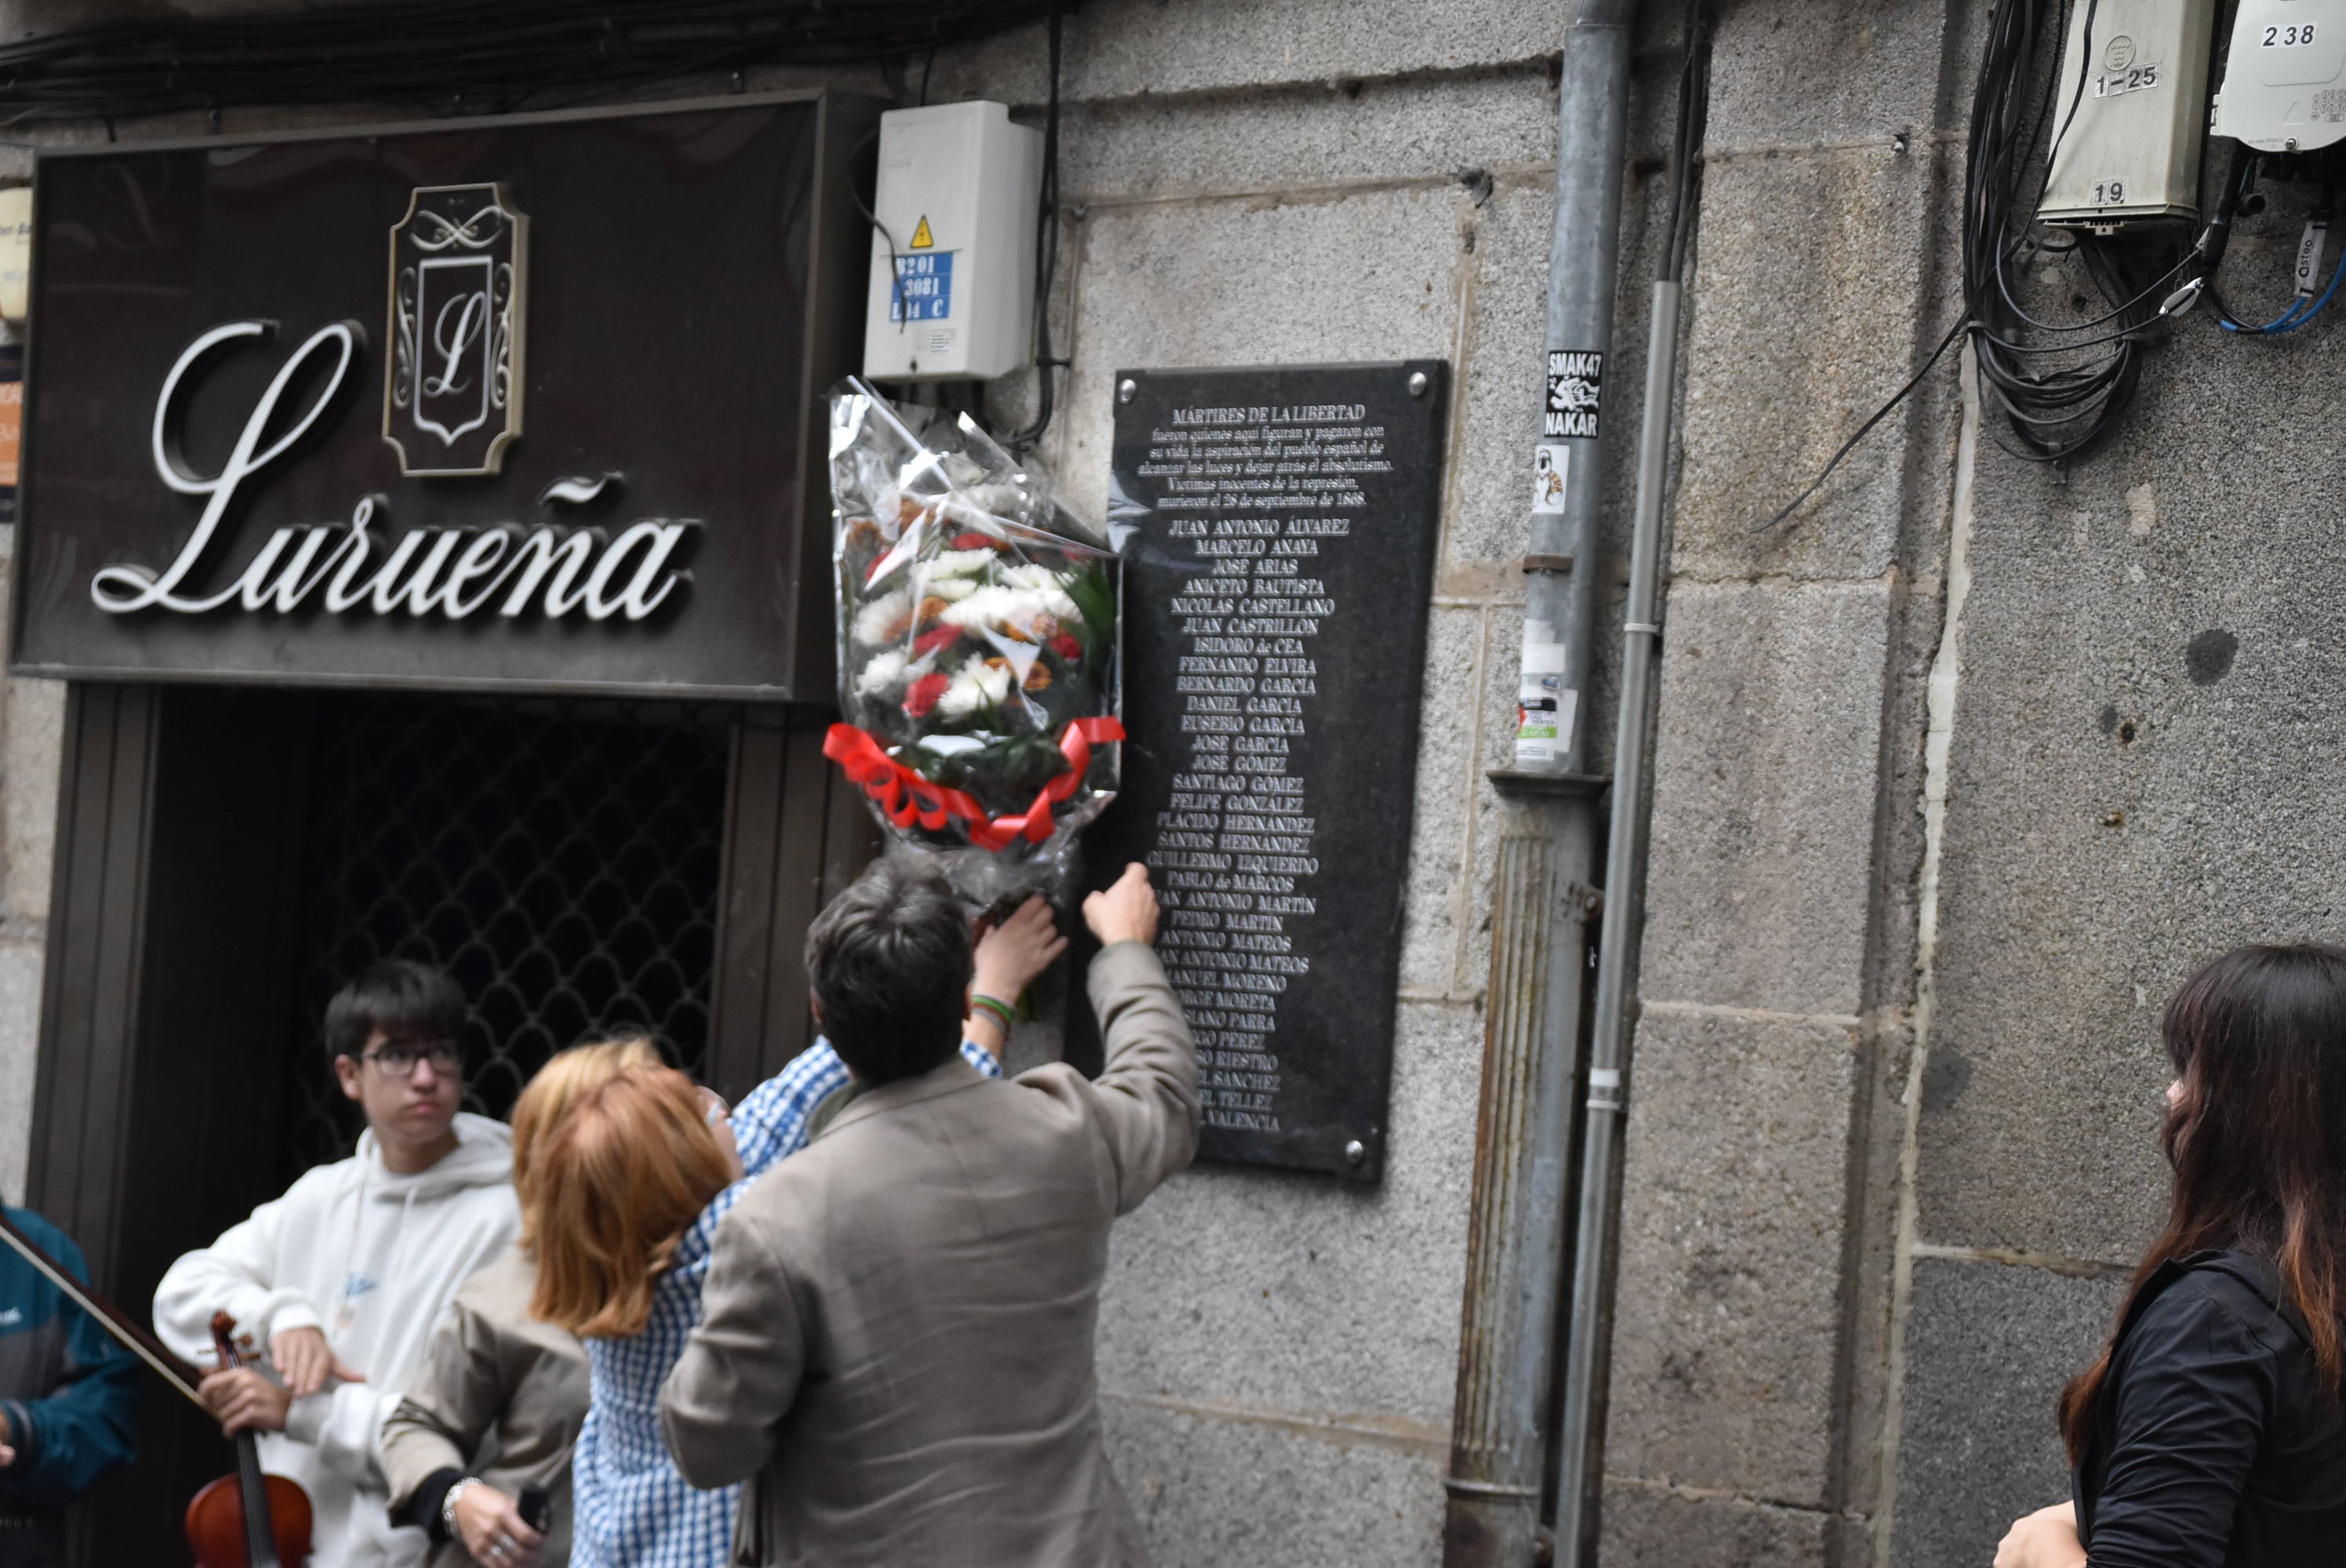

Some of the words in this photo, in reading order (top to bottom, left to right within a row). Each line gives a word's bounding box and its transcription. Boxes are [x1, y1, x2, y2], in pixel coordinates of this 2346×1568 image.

[2262, 24, 2315, 47] 238
[2096, 65, 2156, 95] 1-25
[2094, 182, 2123, 203] 19
[1172, 405, 1246, 424] MÁRTIRES
[1247, 407, 1269, 423] DE
[1270, 406, 1291, 423] LA
[1291, 404, 1366, 422] LIBERTAD
[1363, 426, 1385, 438] con
[1368, 439, 1385, 456] de
[91, 321, 698, 620] Lurueña
[1271, 475, 1287, 490] de
[1239, 492, 1254, 508] de
[1318, 492, 1334, 506] de
[1168, 519, 1208, 537] JUAN
[1212, 518, 1280, 536] ANTONIO
[1284, 515, 1350, 536] ÁLVAREZ
[1195, 539, 1266, 557] MARCELO
[1269, 539, 1319, 557] ANAYA
[1254, 558, 1298, 576] ARIAS
[1182, 578, 1248, 596] ANICETO
[1254, 579, 1325, 597] BAUTISTA
[1238, 598, 1335, 616] CASTELLANO
[1182, 617, 1222, 635] JUAN
[1193, 637, 1255, 655] ISIDORO
[1255, 638, 1272, 655] de
[1273, 638, 1305, 655] CEA
[1178, 655, 1258, 674] FERNANDO
[1177, 676, 1255, 695] BERNARDO
[1186, 695, 1242, 714] DANIEL
[1180, 714, 1244, 734] EUSEBIO
[1172, 773, 1246, 793] SANTIAGO
[1169, 793, 1222, 812] FELIPE
[1166, 870, 1214, 889] PABLO
[1215, 873, 1231, 891] de
[1231, 873, 1295, 894] MARCOS
[1185, 891, 1253, 910] ANTONIO
[1160, 929, 1226, 949] ANTONIO
[1229, 932, 1292, 953] MATEOS
[1181, 949, 1247, 971] ANTONIO
[1247, 953, 1309, 975] MATEOS
[1221, 971, 1287, 993] MORENO
[1227, 1012, 1276, 1033] PARRA
